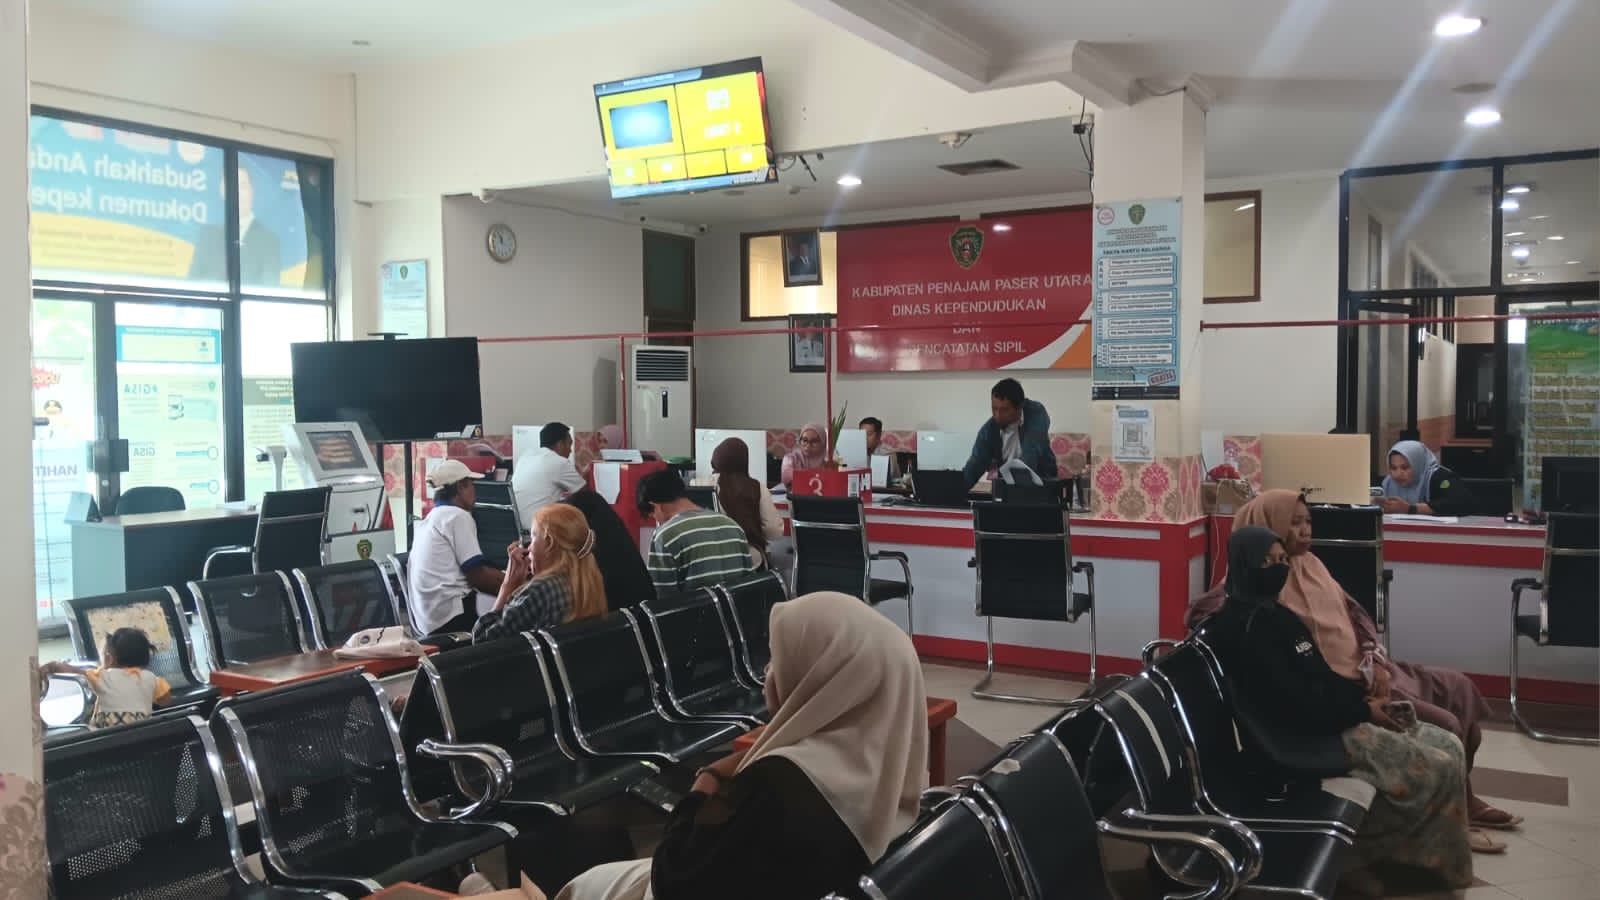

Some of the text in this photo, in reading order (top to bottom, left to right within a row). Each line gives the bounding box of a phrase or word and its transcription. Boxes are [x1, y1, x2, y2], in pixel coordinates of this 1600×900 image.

[852, 274, 1092, 297] KABUPATEN PENAJAM PASER UTARA
[892, 298, 1046, 316] DINAS KEPENDUDUKAN
[994, 342, 1026, 353] SIPIL
